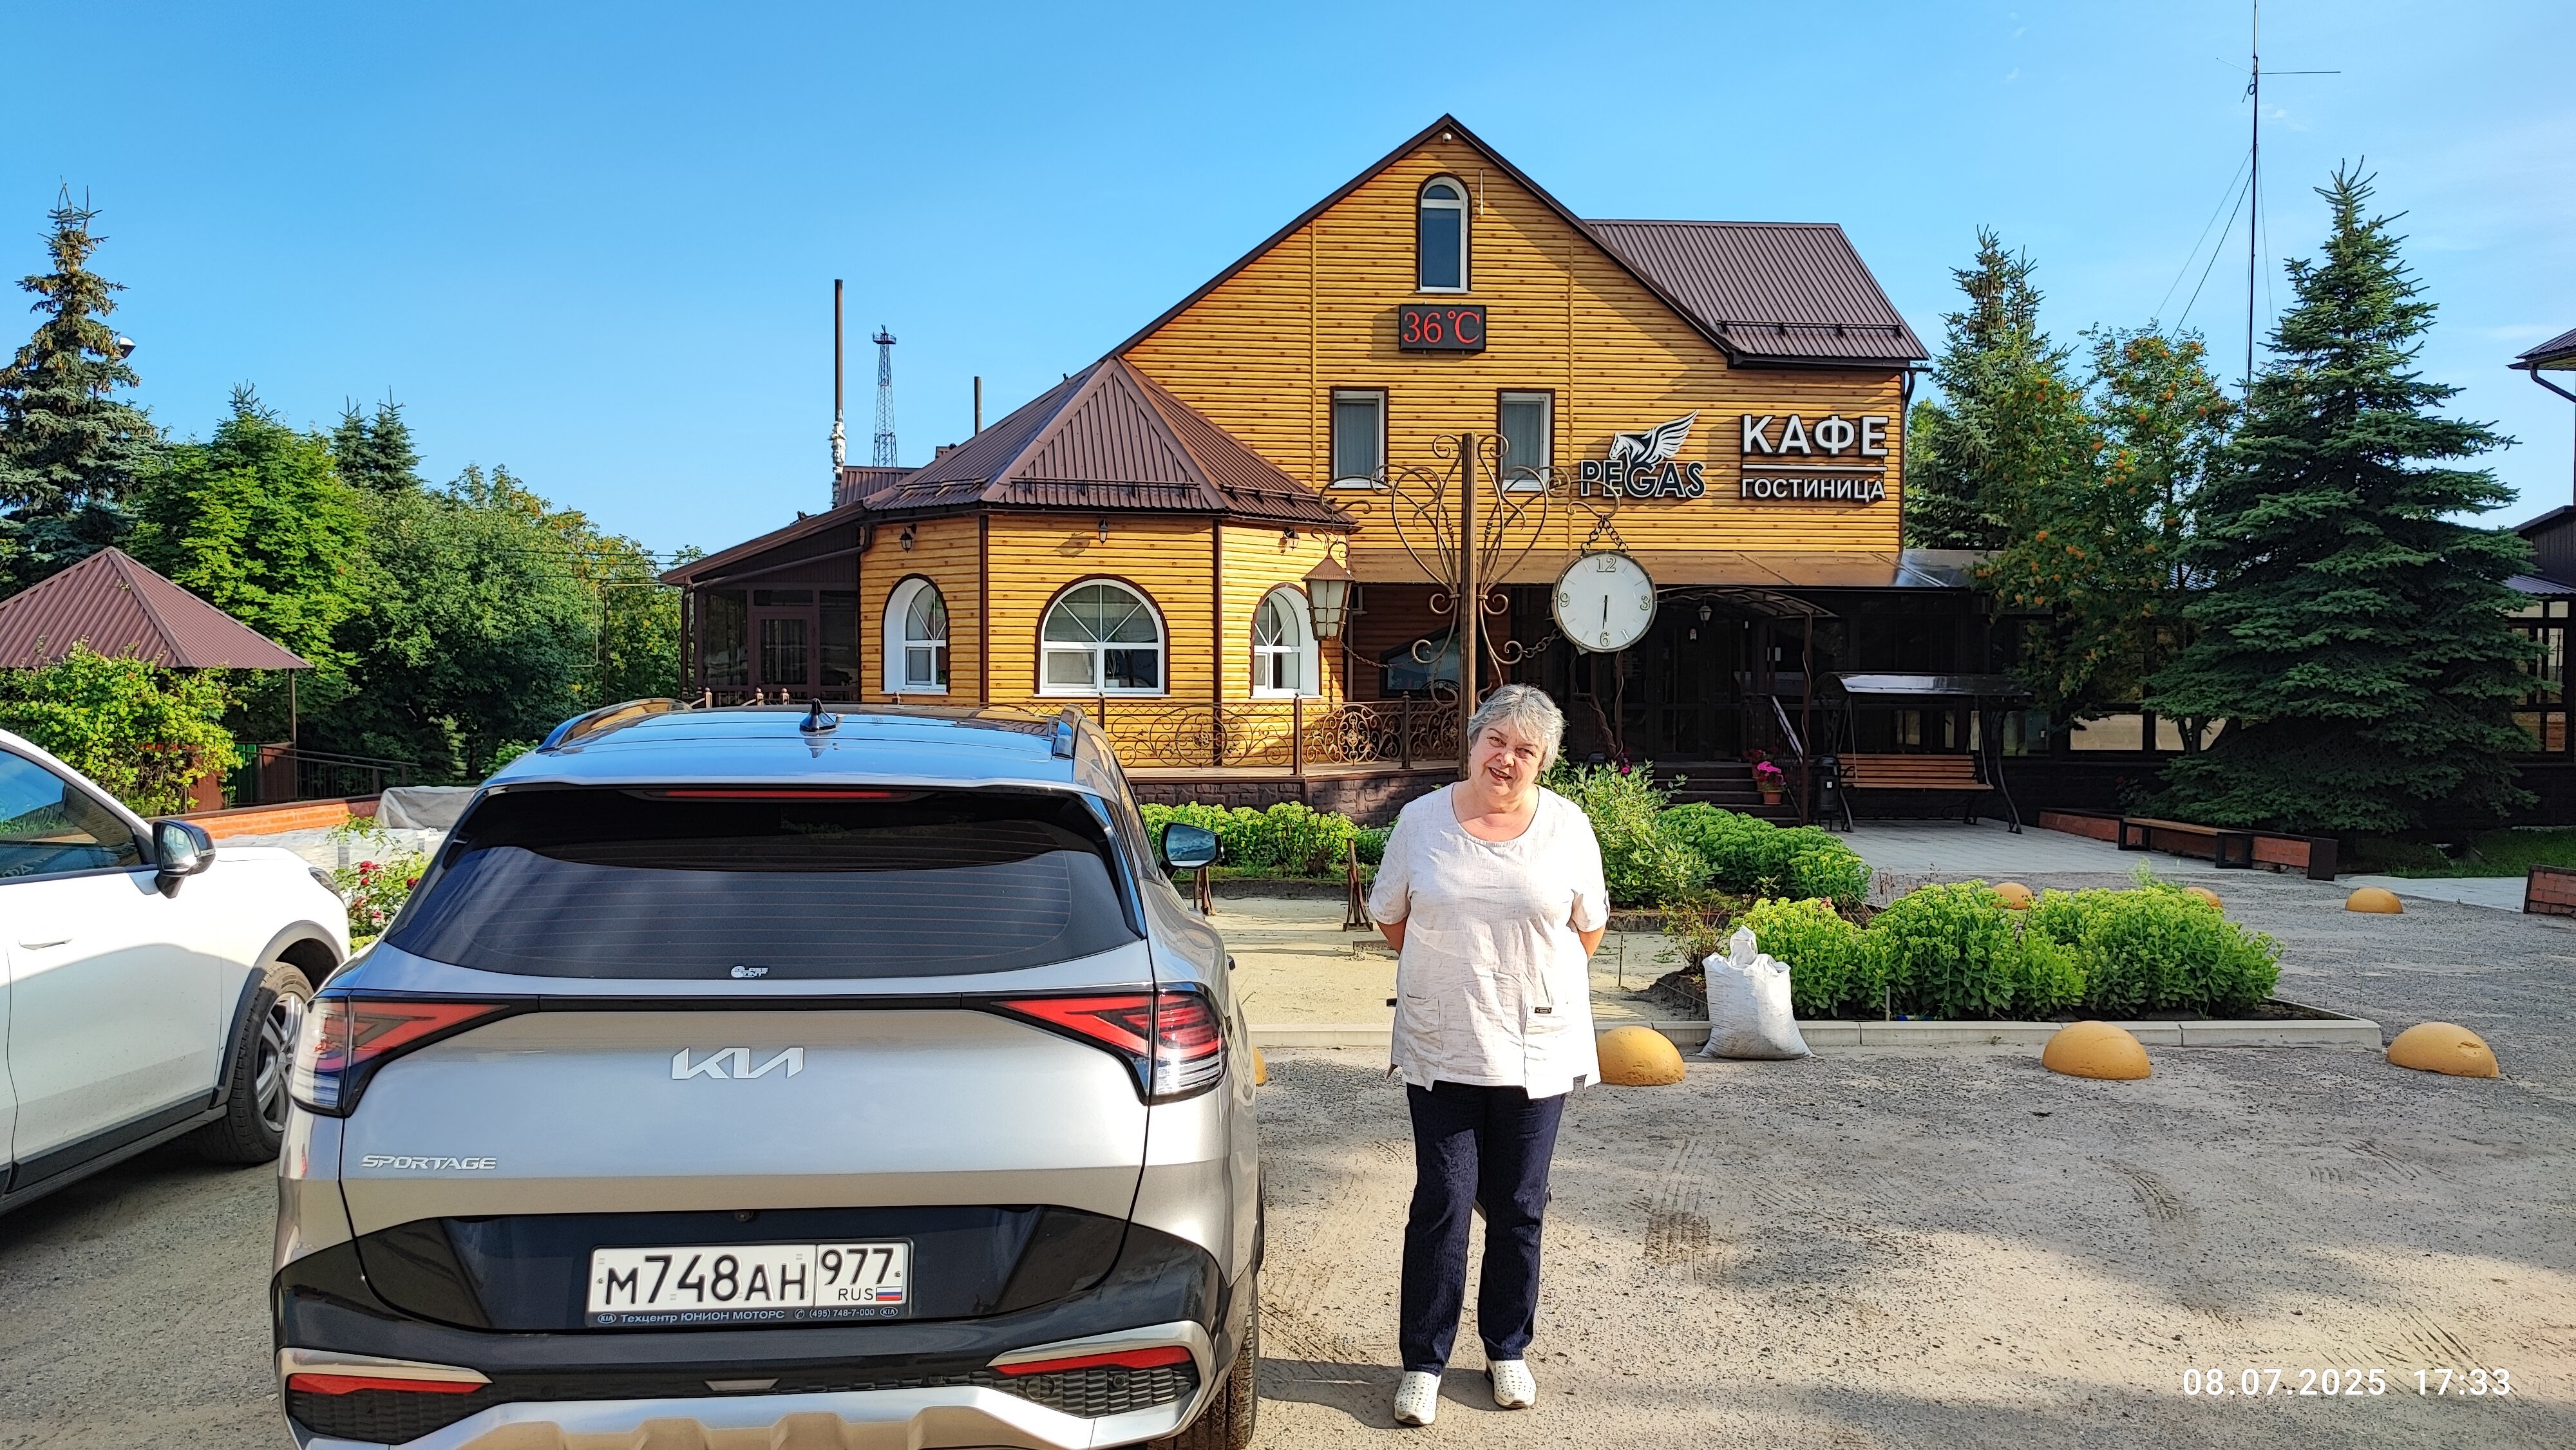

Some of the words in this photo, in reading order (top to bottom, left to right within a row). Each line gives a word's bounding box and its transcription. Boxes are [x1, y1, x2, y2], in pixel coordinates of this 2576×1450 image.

[1742, 414, 1889, 456] КАФЕ
[1580, 460, 1706, 498] PEGAS
[1742, 478, 1886, 502] ГОСТИНИЦА
[1596, 556, 1616, 572] 12
[1560, 592, 1570, 607] 9
[1640, 595, 1651, 610] 3
[1600, 631, 1610, 646] 6
[671, 1047, 804, 1080] KIA
[361, 1154, 498, 1171] SPORTAGE
[820, 1247, 895, 1286] 977
[838, 1287, 874, 1301] RUS
[621, 1314, 677, 1323] Техцентр
[681, 1312, 729, 1321] ЮНИОН
[733, 1310, 784, 1320] МОТОРС
[809, 1308, 831, 1318] (495)
[833, 1308, 875, 1317] 748-7-000
